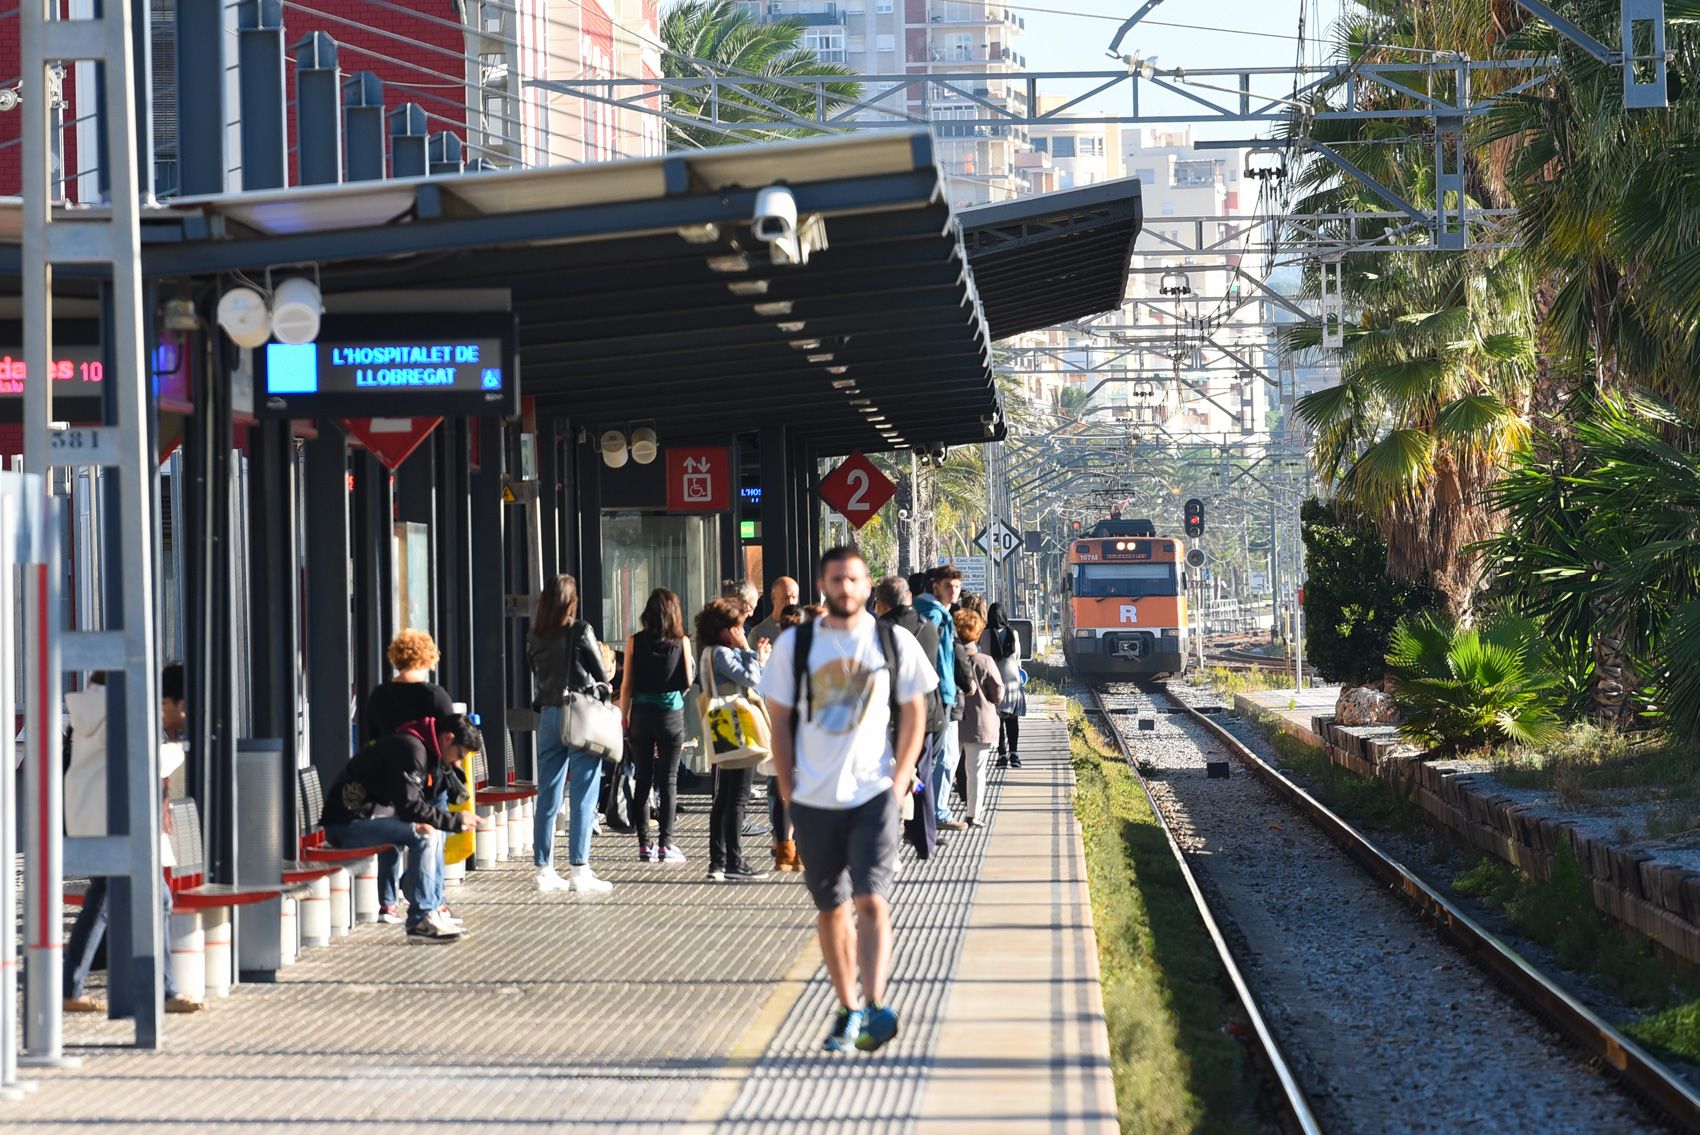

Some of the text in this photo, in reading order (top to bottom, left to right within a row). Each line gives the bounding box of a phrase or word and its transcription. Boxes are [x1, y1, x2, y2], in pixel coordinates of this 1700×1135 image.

[333, 345, 480, 365] L'HOSPITALET DE
[80, 361, 103, 382] 10
[356, 367, 457, 387] LLOBREGAT
[847, 468, 870, 511] 2
[1119, 604, 1138, 623] R
